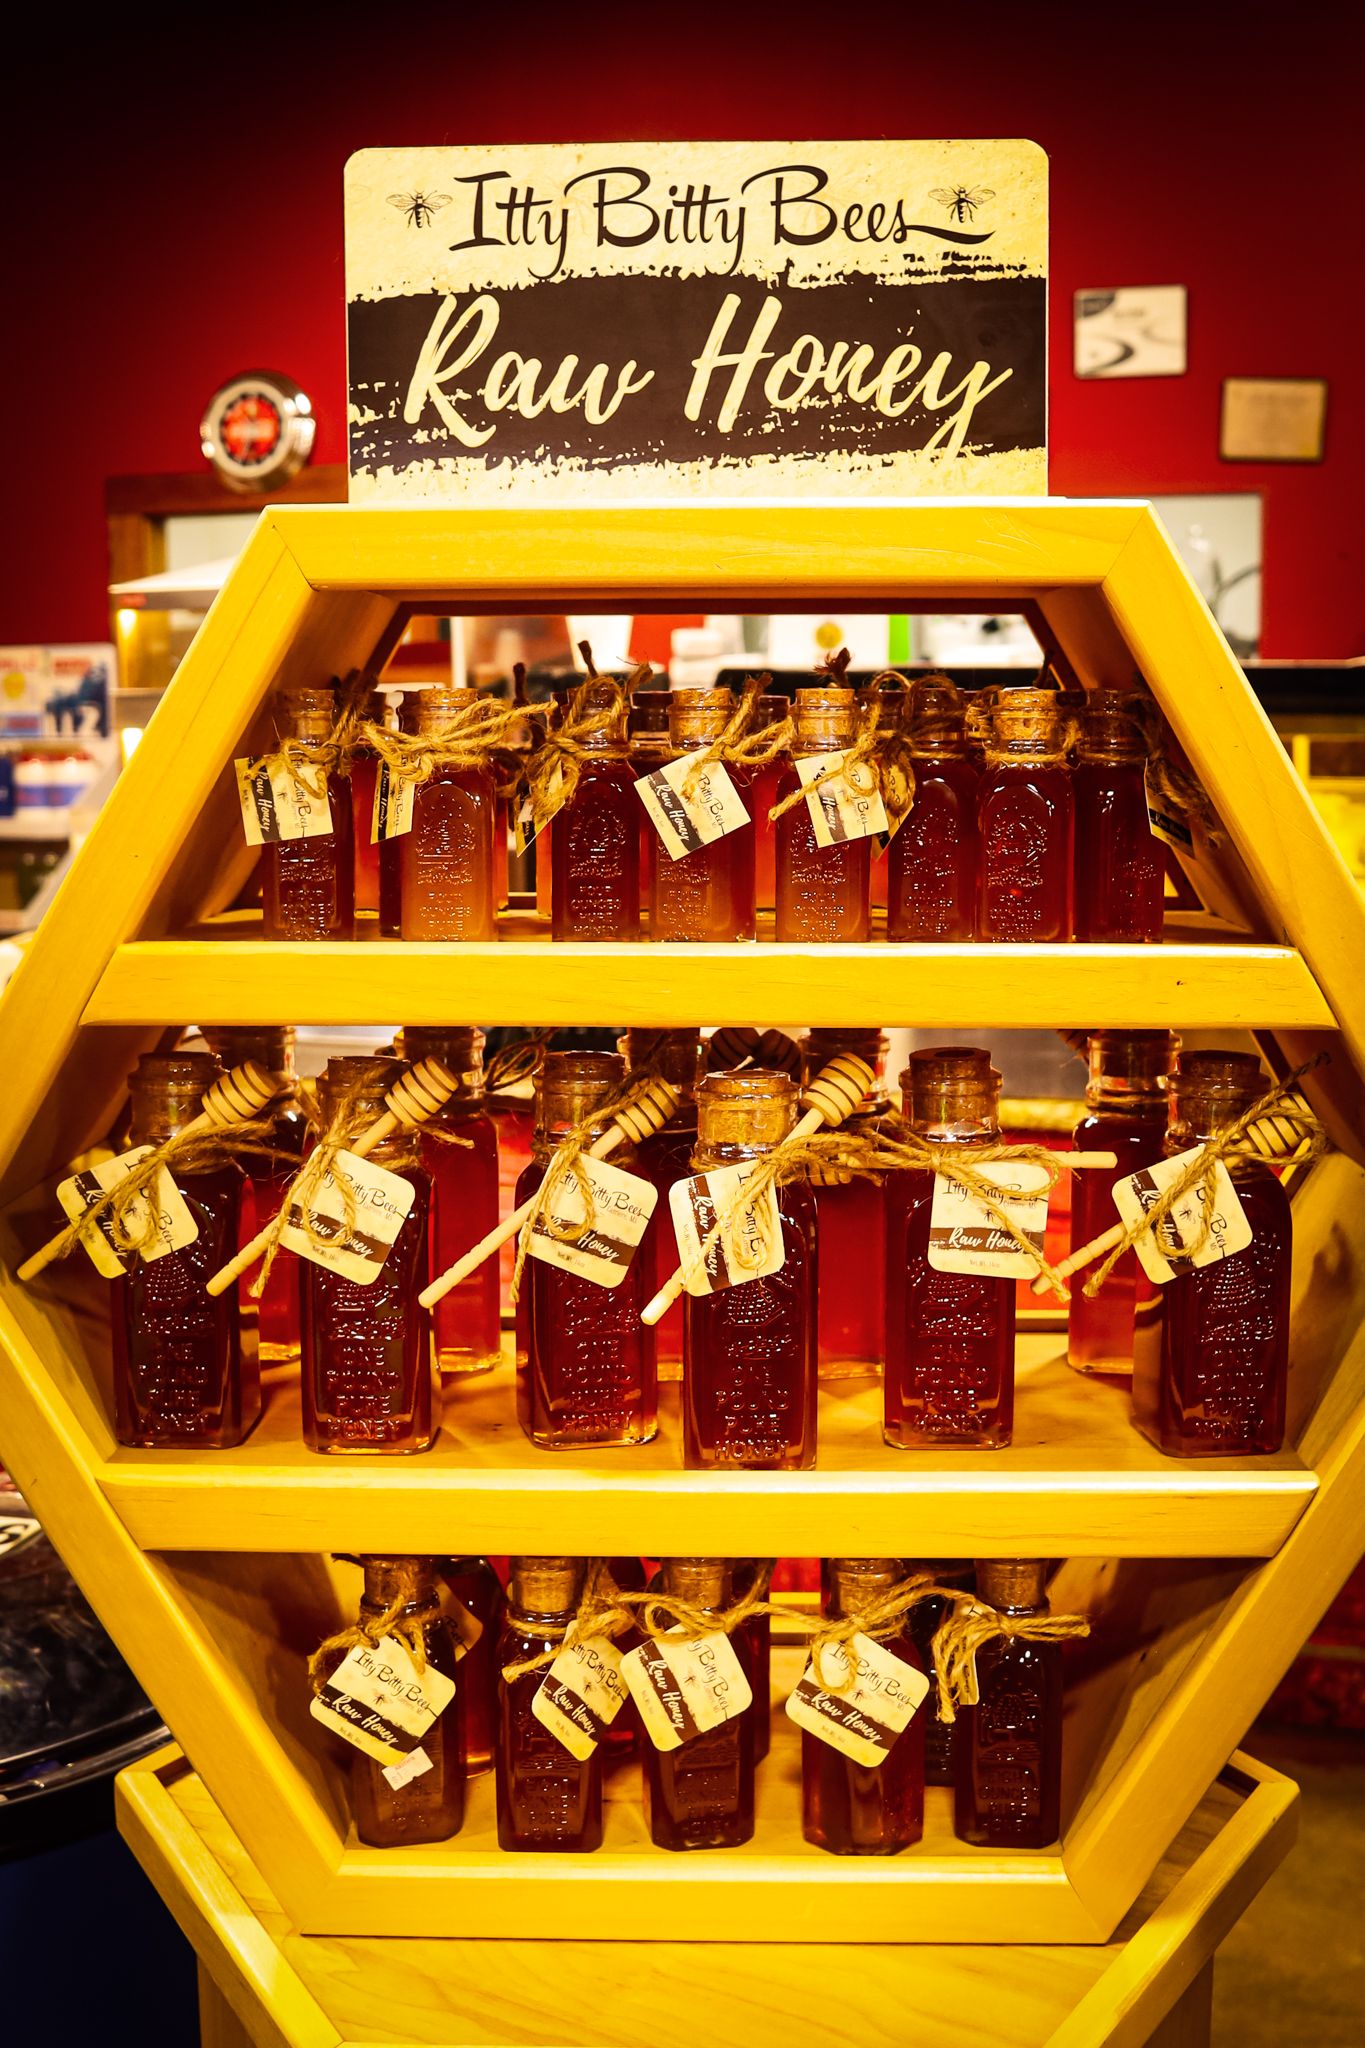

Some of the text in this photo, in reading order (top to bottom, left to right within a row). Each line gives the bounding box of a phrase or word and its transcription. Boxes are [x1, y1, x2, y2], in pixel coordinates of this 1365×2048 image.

[449, 164, 996, 279] Itty Bitty Bees
[403, 293, 1014, 463] Raw Honey
[257, 798, 273, 832] Honey
[655, 784, 673, 809] Raw
[668, 809, 691, 842] Honey
[821, 795, 838, 831] Honey
[369, 1186, 406, 1220] Bees
[611, 1190, 652, 1221] Bees
[693, 1195, 714, 1231] Raw
[576, 1230, 621, 1263] Honey
[948, 1226, 1025, 1256] Raw Honey
[1210, 1211, 1228, 1258] Bees
[353, 1648, 439, 1719] Itty Bitty Bees
[584, 1649, 607, 1684] Bitty
[604, 1668, 625, 1701] Bees
[648, 1658, 686, 1731] Raw Honey
[699, 1644, 718, 1685] Bitty
[712, 1678, 730, 1721] Bees
[855, 1656, 884, 1692] Bitty
[882, 1675, 918, 1711] Bees
[331, 1694, 362, 1720] Raw
[360, 1713, 399, 1746] Honey
[552, 1684, 575, 1712] Raw
[571, 1702, 598, 1736] Honey
[810, 1689, 844, 1719] Raw
[841, 1709, 883, 1744] Honey
